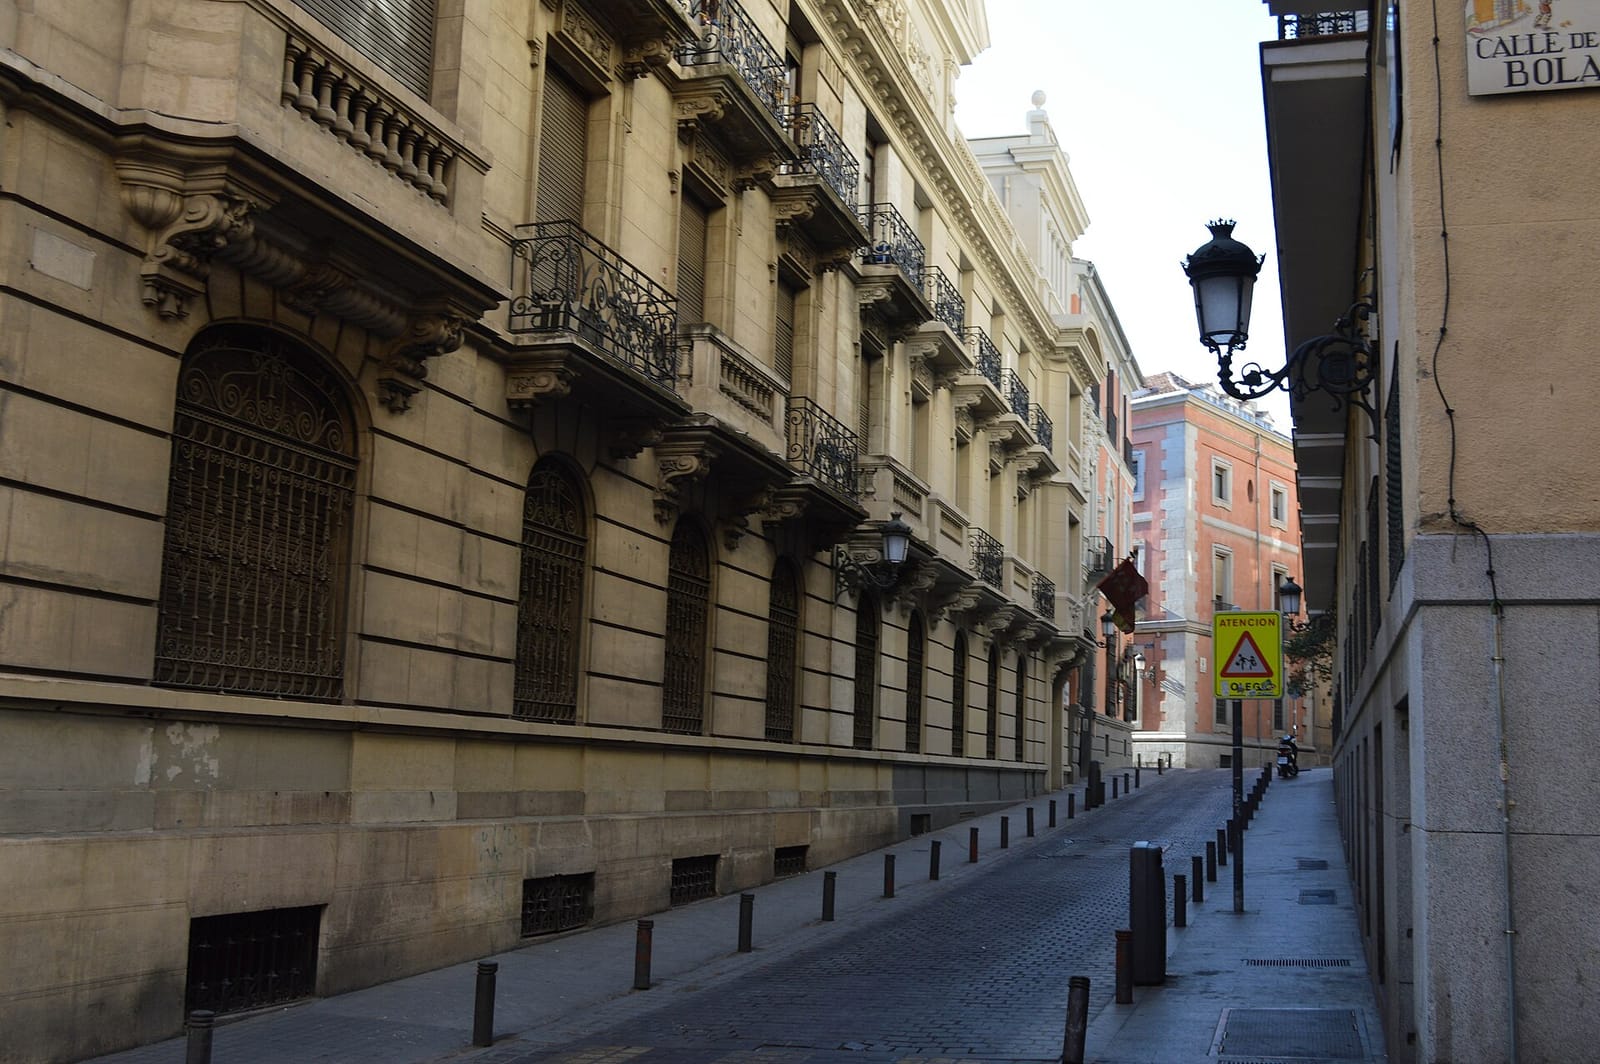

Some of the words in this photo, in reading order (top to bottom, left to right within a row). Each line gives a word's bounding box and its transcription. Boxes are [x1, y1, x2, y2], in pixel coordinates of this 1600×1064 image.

[1476, 32, 1564, 59] CALLE
[1568, 32, 1599, 49] DE
[1503, 55, 1600, 88] BOLA
[1220, 618, 1275, 627] ATENCION
